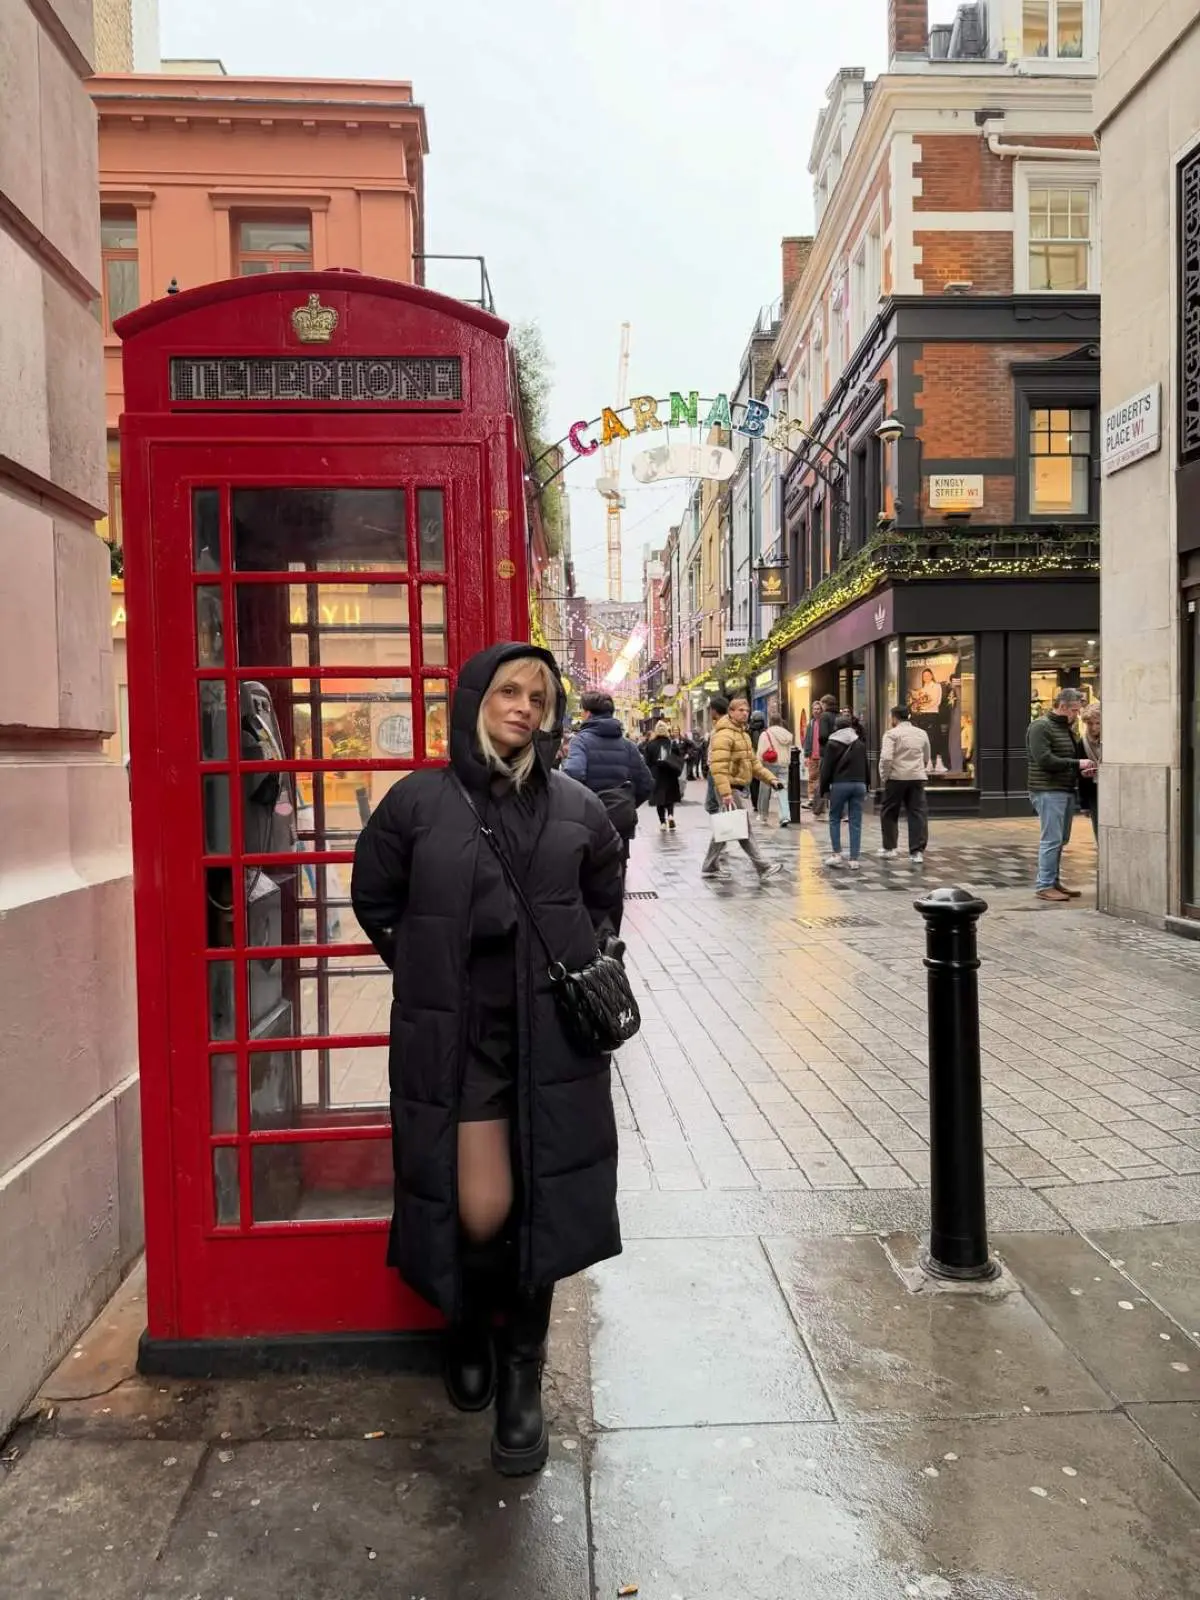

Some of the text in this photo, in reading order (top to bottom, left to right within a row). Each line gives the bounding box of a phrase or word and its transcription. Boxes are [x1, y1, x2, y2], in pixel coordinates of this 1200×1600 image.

[187, 360, 453, 399] TELEPHONE
[1106, 392, 1151, 433] FOUBERT'S
[1106, 418, 1144, 453] PLACE W1
[935, 478, 965, 487] KINGLY
[935, 488, 979, 497] STREET W1
